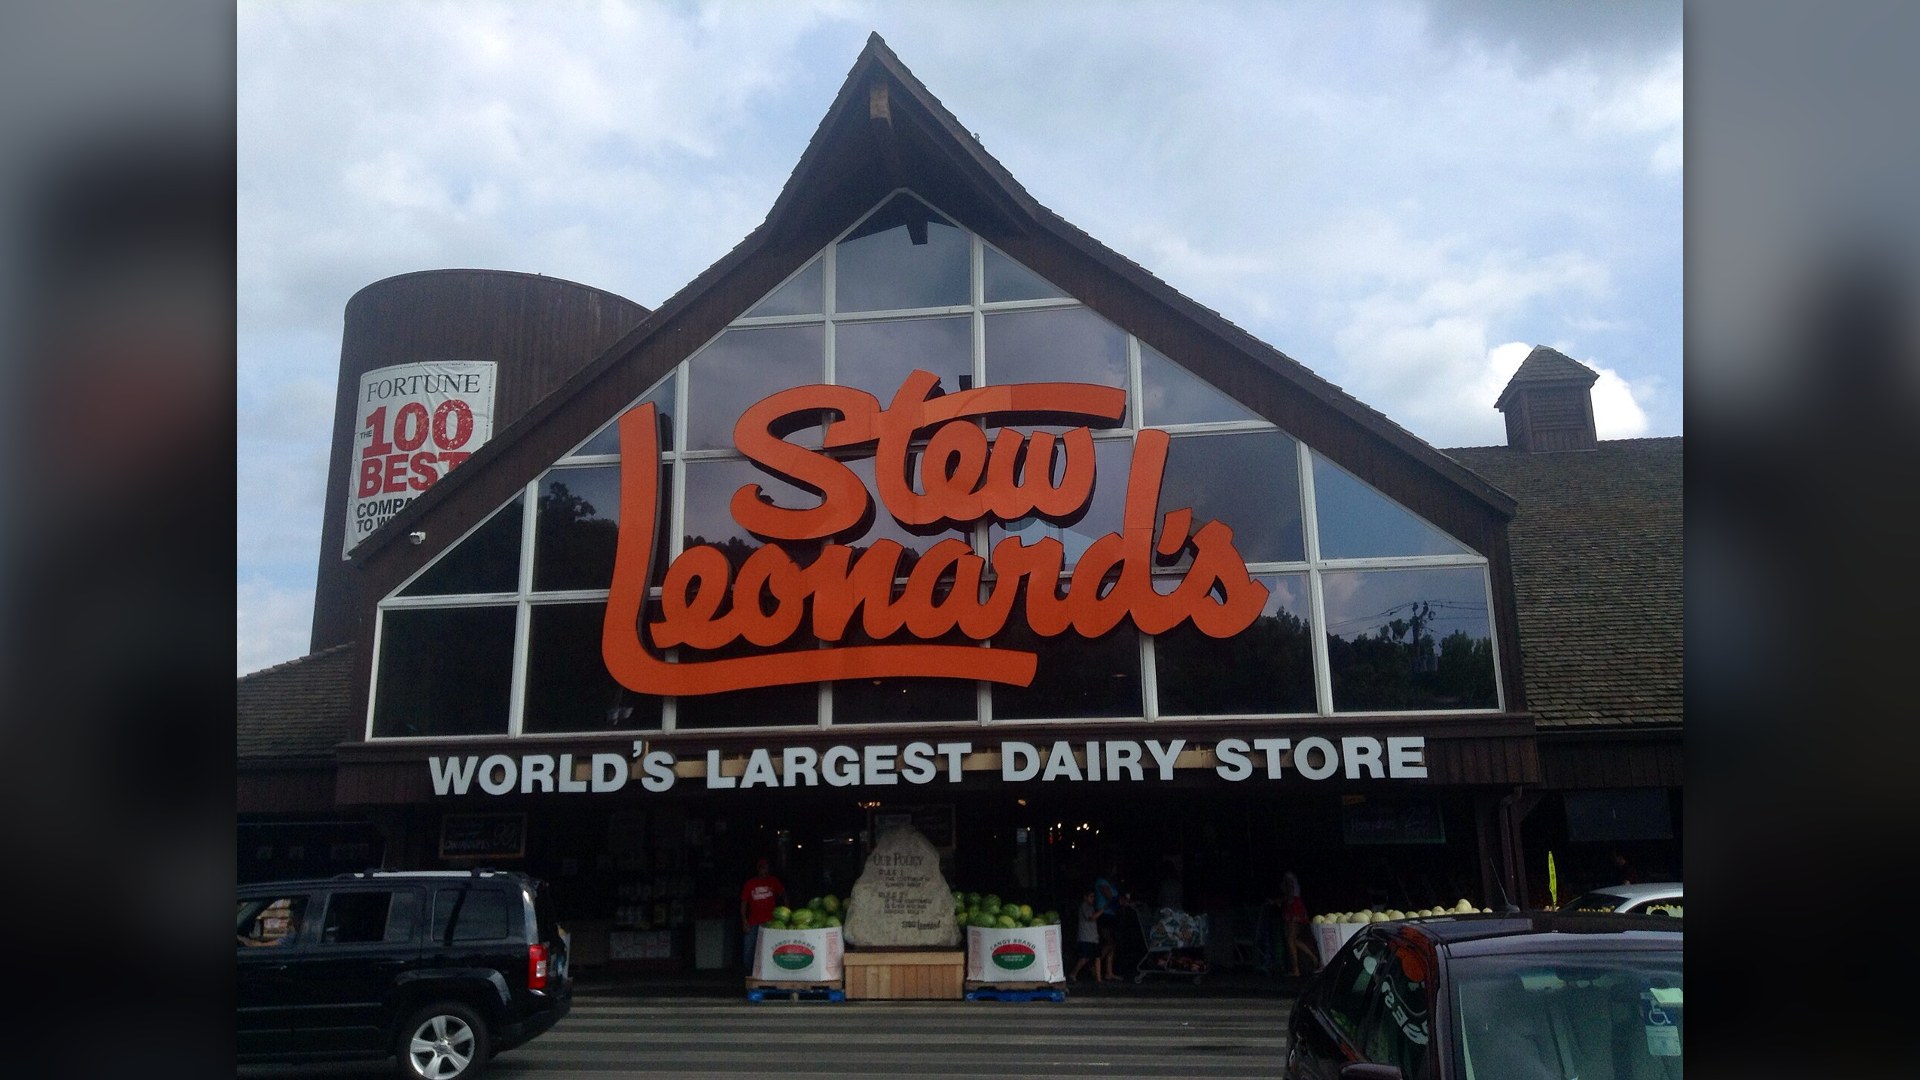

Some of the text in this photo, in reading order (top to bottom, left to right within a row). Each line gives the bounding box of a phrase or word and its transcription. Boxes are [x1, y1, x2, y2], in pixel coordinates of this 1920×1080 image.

[367, 374, 481, 402] FORTUNE
[360, 399, 474, 459] THE 100
[731, 369, 1126, 542] Stew
[358, 451, 472, 499] BEST
[357, 518, 373, 533] TO
[602, 402, 1270, 696] Leonard's
[429, 736, 1428, 796] WORLD'S LARGEST DAIRY STORE
